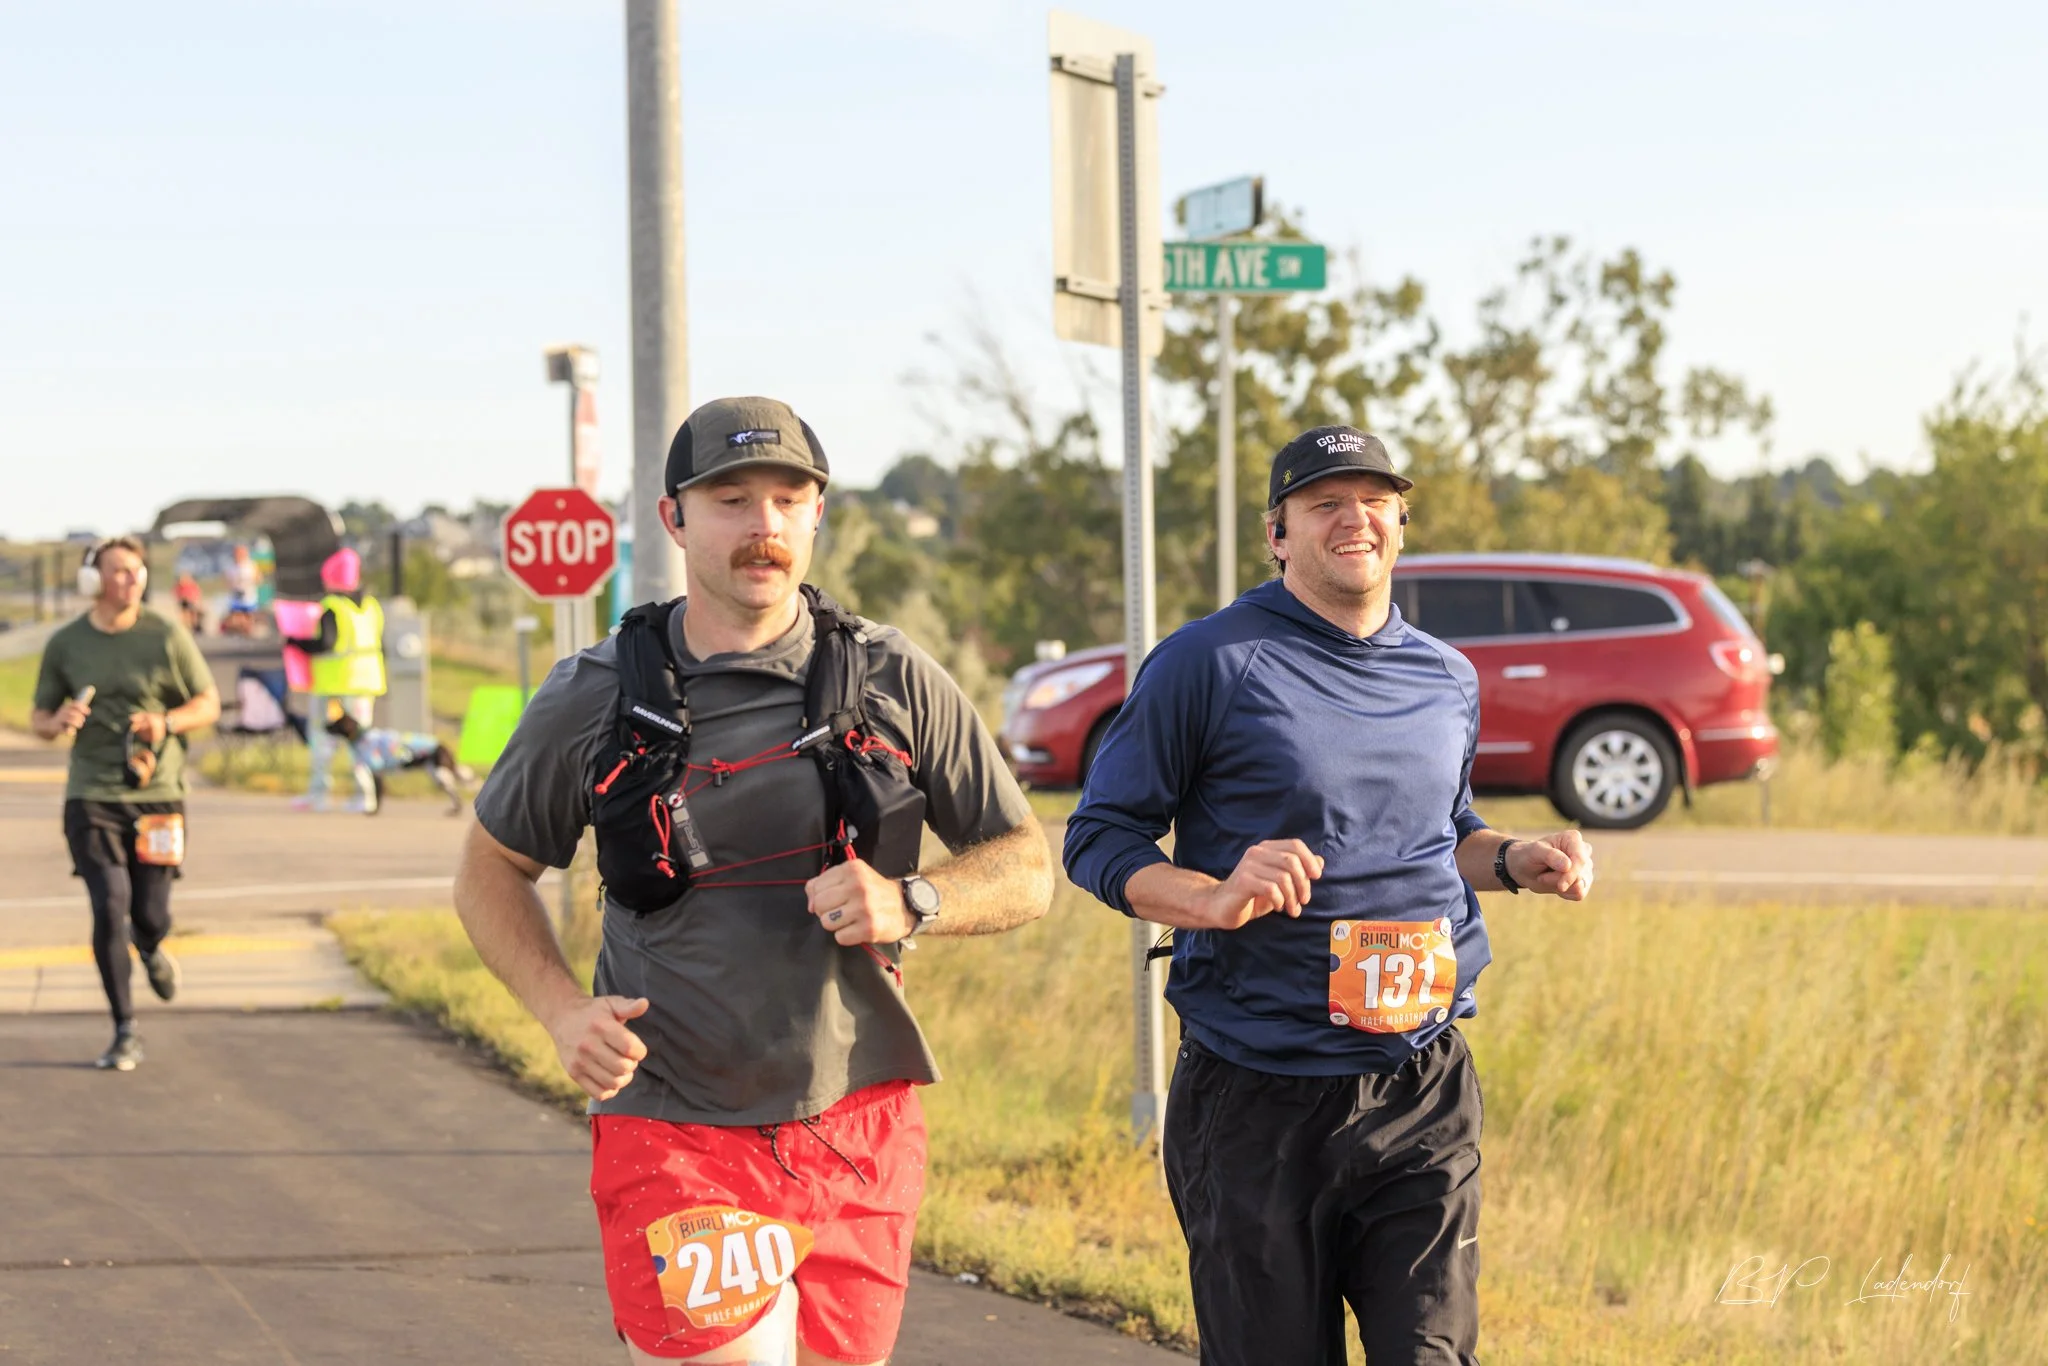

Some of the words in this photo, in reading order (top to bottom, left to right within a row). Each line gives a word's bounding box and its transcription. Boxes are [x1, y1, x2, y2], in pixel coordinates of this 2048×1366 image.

[1212, 247, 1271, 287] AVE
[1316, 434, 1336, 448] GO
[1339, 433, 1366, 447] ONE
[1327, 442, 1363, 455] MORE
[510, 520, 612, 567] STOP
[1356, 952, 1436, 1009] 131
[1360, 1015, 1384, 1027] HALF
[1386, 1010, 1429, 1025] MARATHON
[676, 1223, 796, 1310] 240
[704, 1307, 731, 1325] HALF
